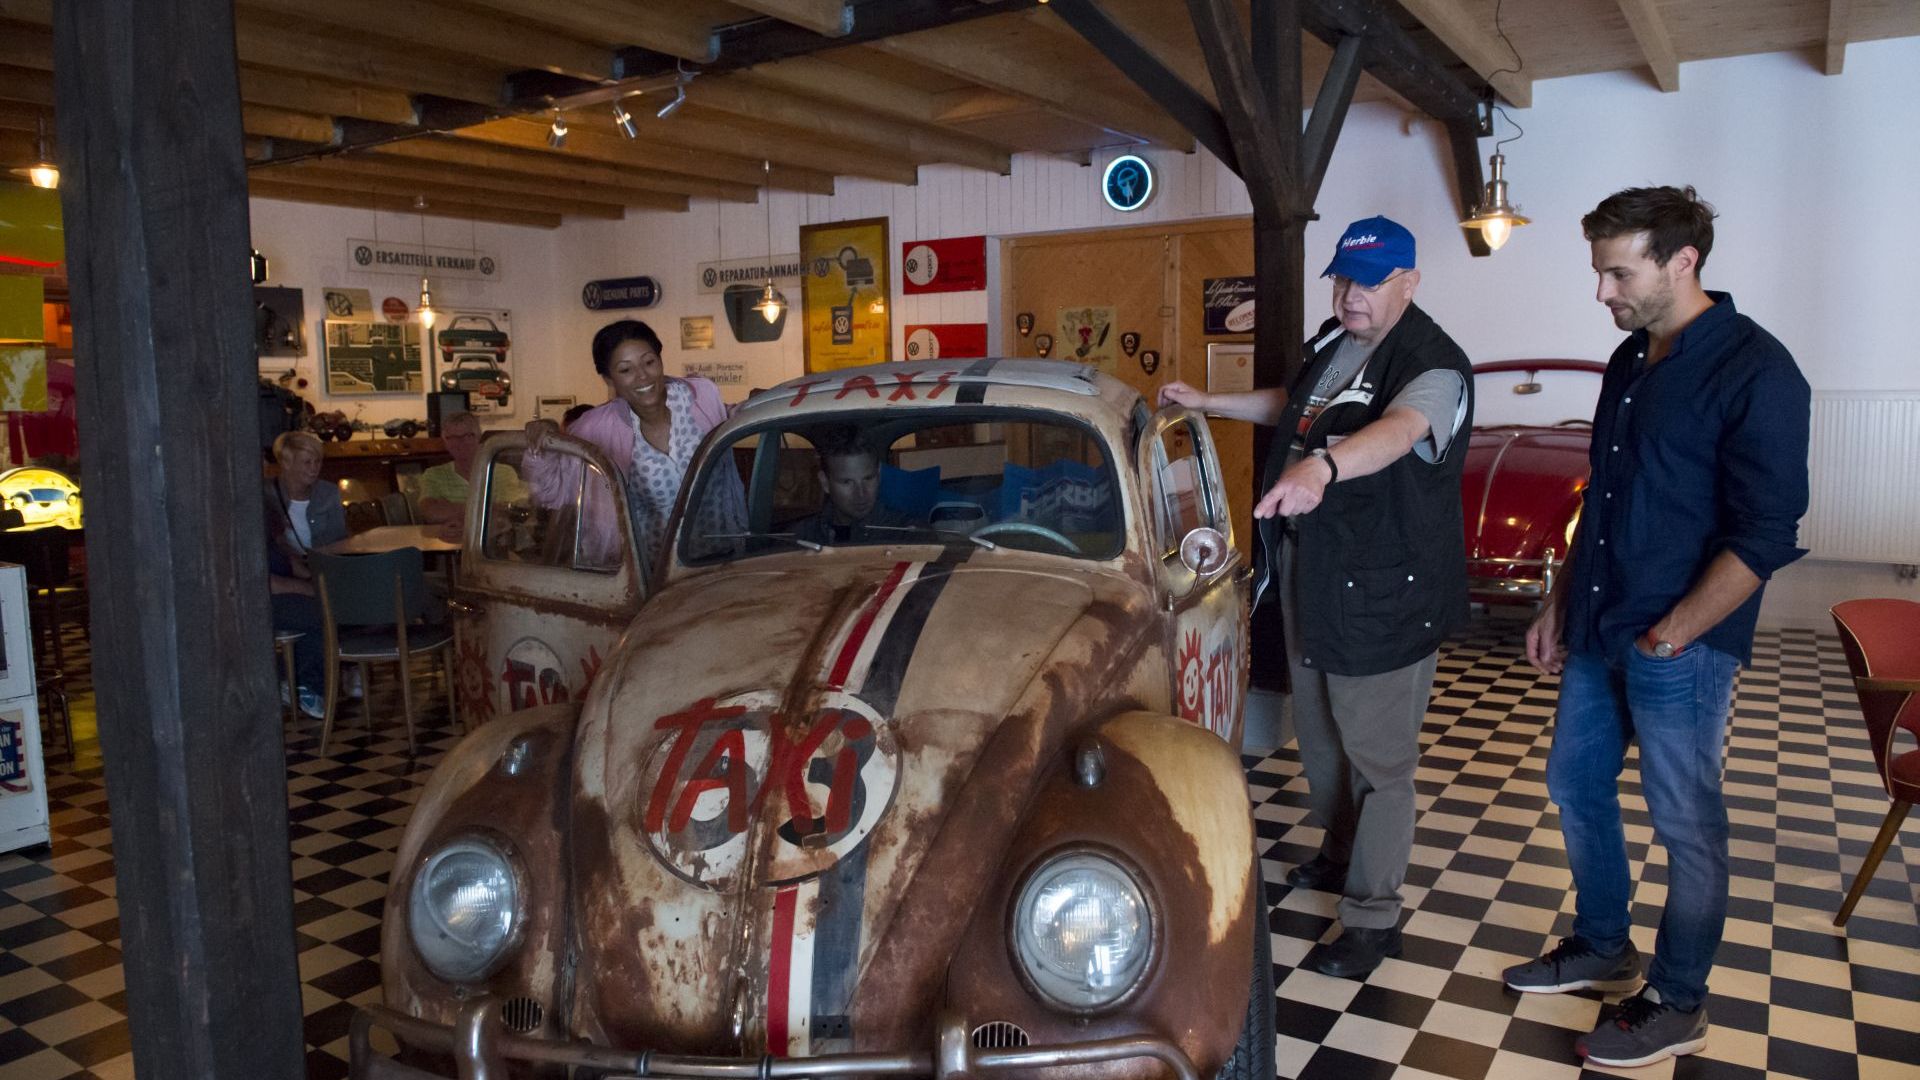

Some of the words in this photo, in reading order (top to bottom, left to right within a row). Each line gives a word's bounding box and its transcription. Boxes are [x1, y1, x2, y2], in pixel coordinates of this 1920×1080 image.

[1342, 235, 1377, 249] Herbie
[375, 251, 433, 267] ERSATZTEILE
[435, 256, 476, 270] VERKAUF
[603, 288, 628, 301] GENUINE
[629, 285, 649, 298] PARTS
